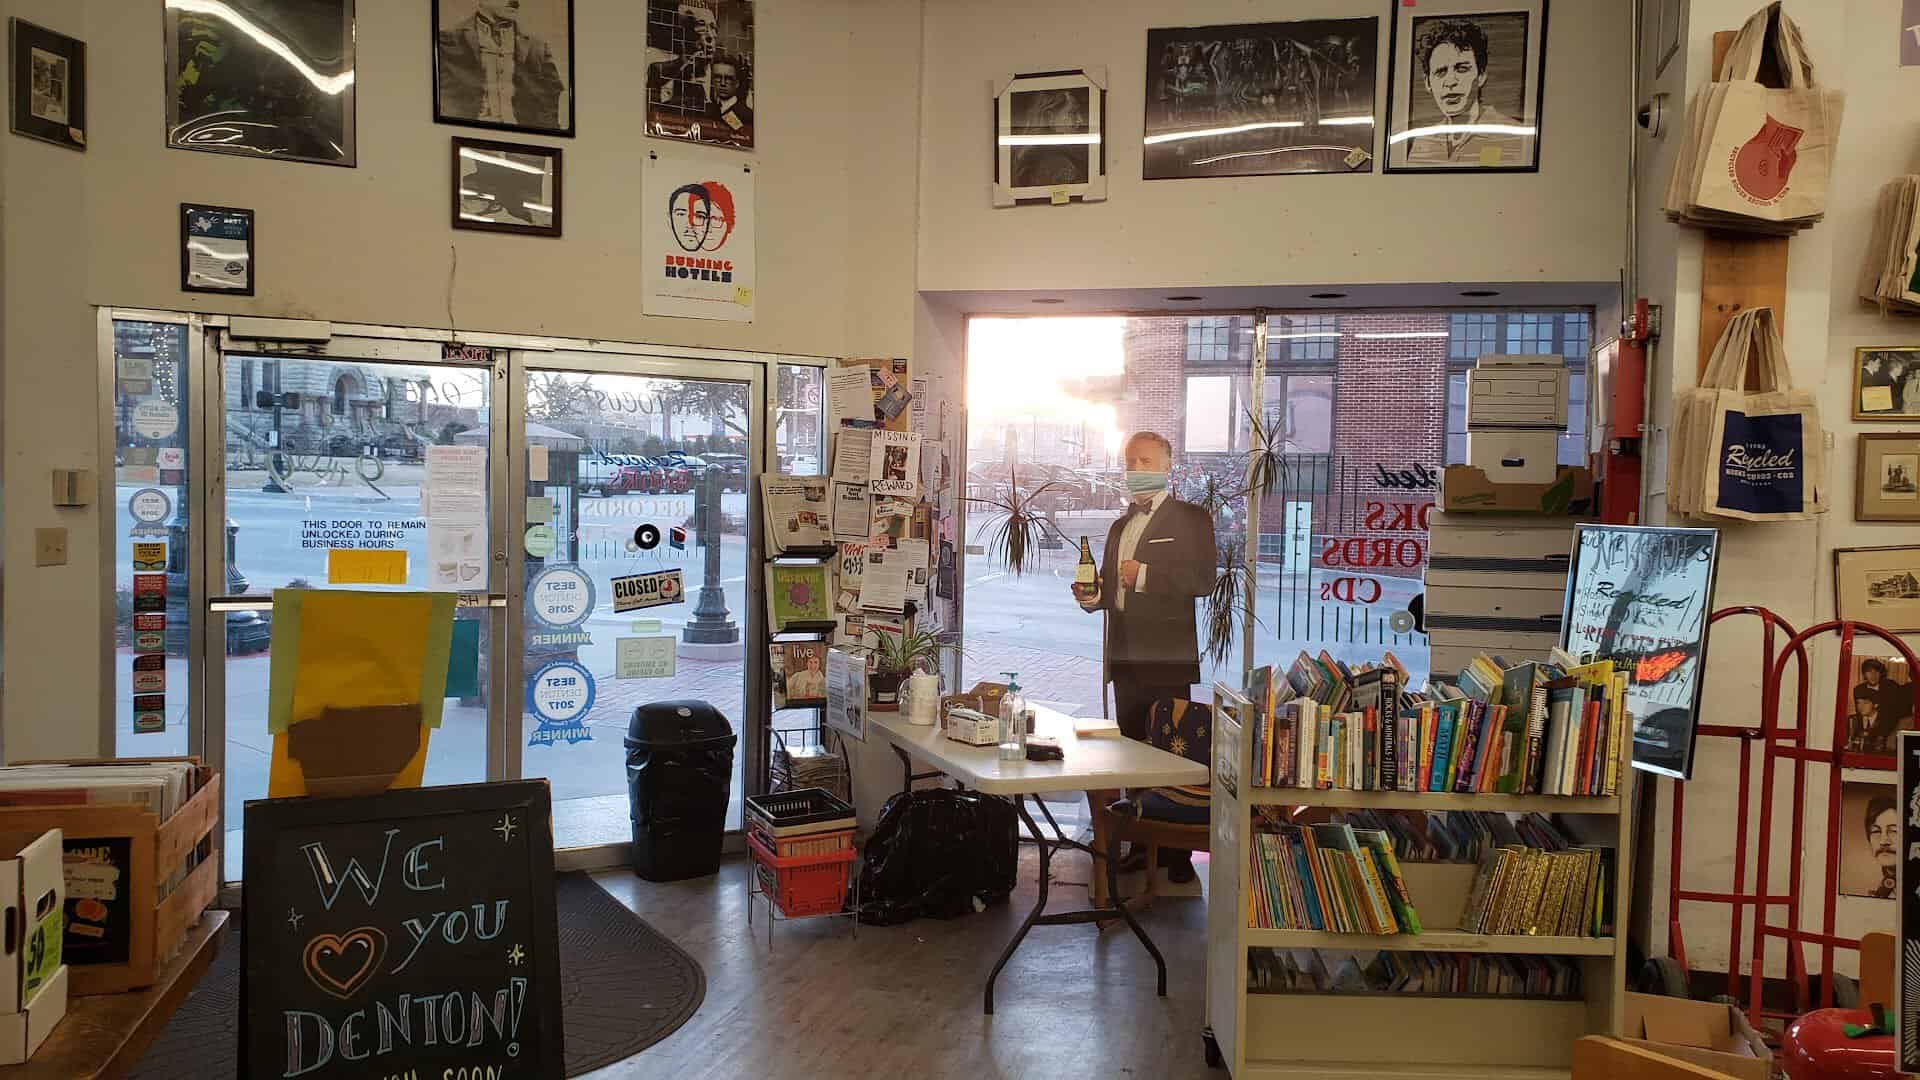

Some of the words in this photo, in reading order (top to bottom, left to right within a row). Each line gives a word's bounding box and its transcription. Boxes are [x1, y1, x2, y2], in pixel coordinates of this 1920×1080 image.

[1727, 145, 1740, 178] RECYCLED
[665, 255, 733, 271] BURNING
[665, 266, 732, 283] HOTELS
[447, 346, 489, 361] EXIT
[873, 431, 917, 441] MISSING
[872, 479, 914, 494] REWARD
[302, 520, 327, 529] THIS
[332, 520, 362, 529] DOOR
[368, 520, 383, 529] TO
[387, 520, 426, 529] REMAIN
[302, 530, 360, 539] UNLOCKED
[365, 530, 405, 539] DURING
[302, 540, 354, 549] BUSINESS
[360, 540, 395, 549] HOURS
[614, 577, 658, 599] CLOSED
[793, 645, 815, 659] live
[1383, 697, 1393, 718] ROCKS
[1383, 724, 1393, 755] MINERALS
[300, 829, 446, 910] WE
[391, 900, 510, 975] YOU
[283, 977, 528, 1078] DENTON!
